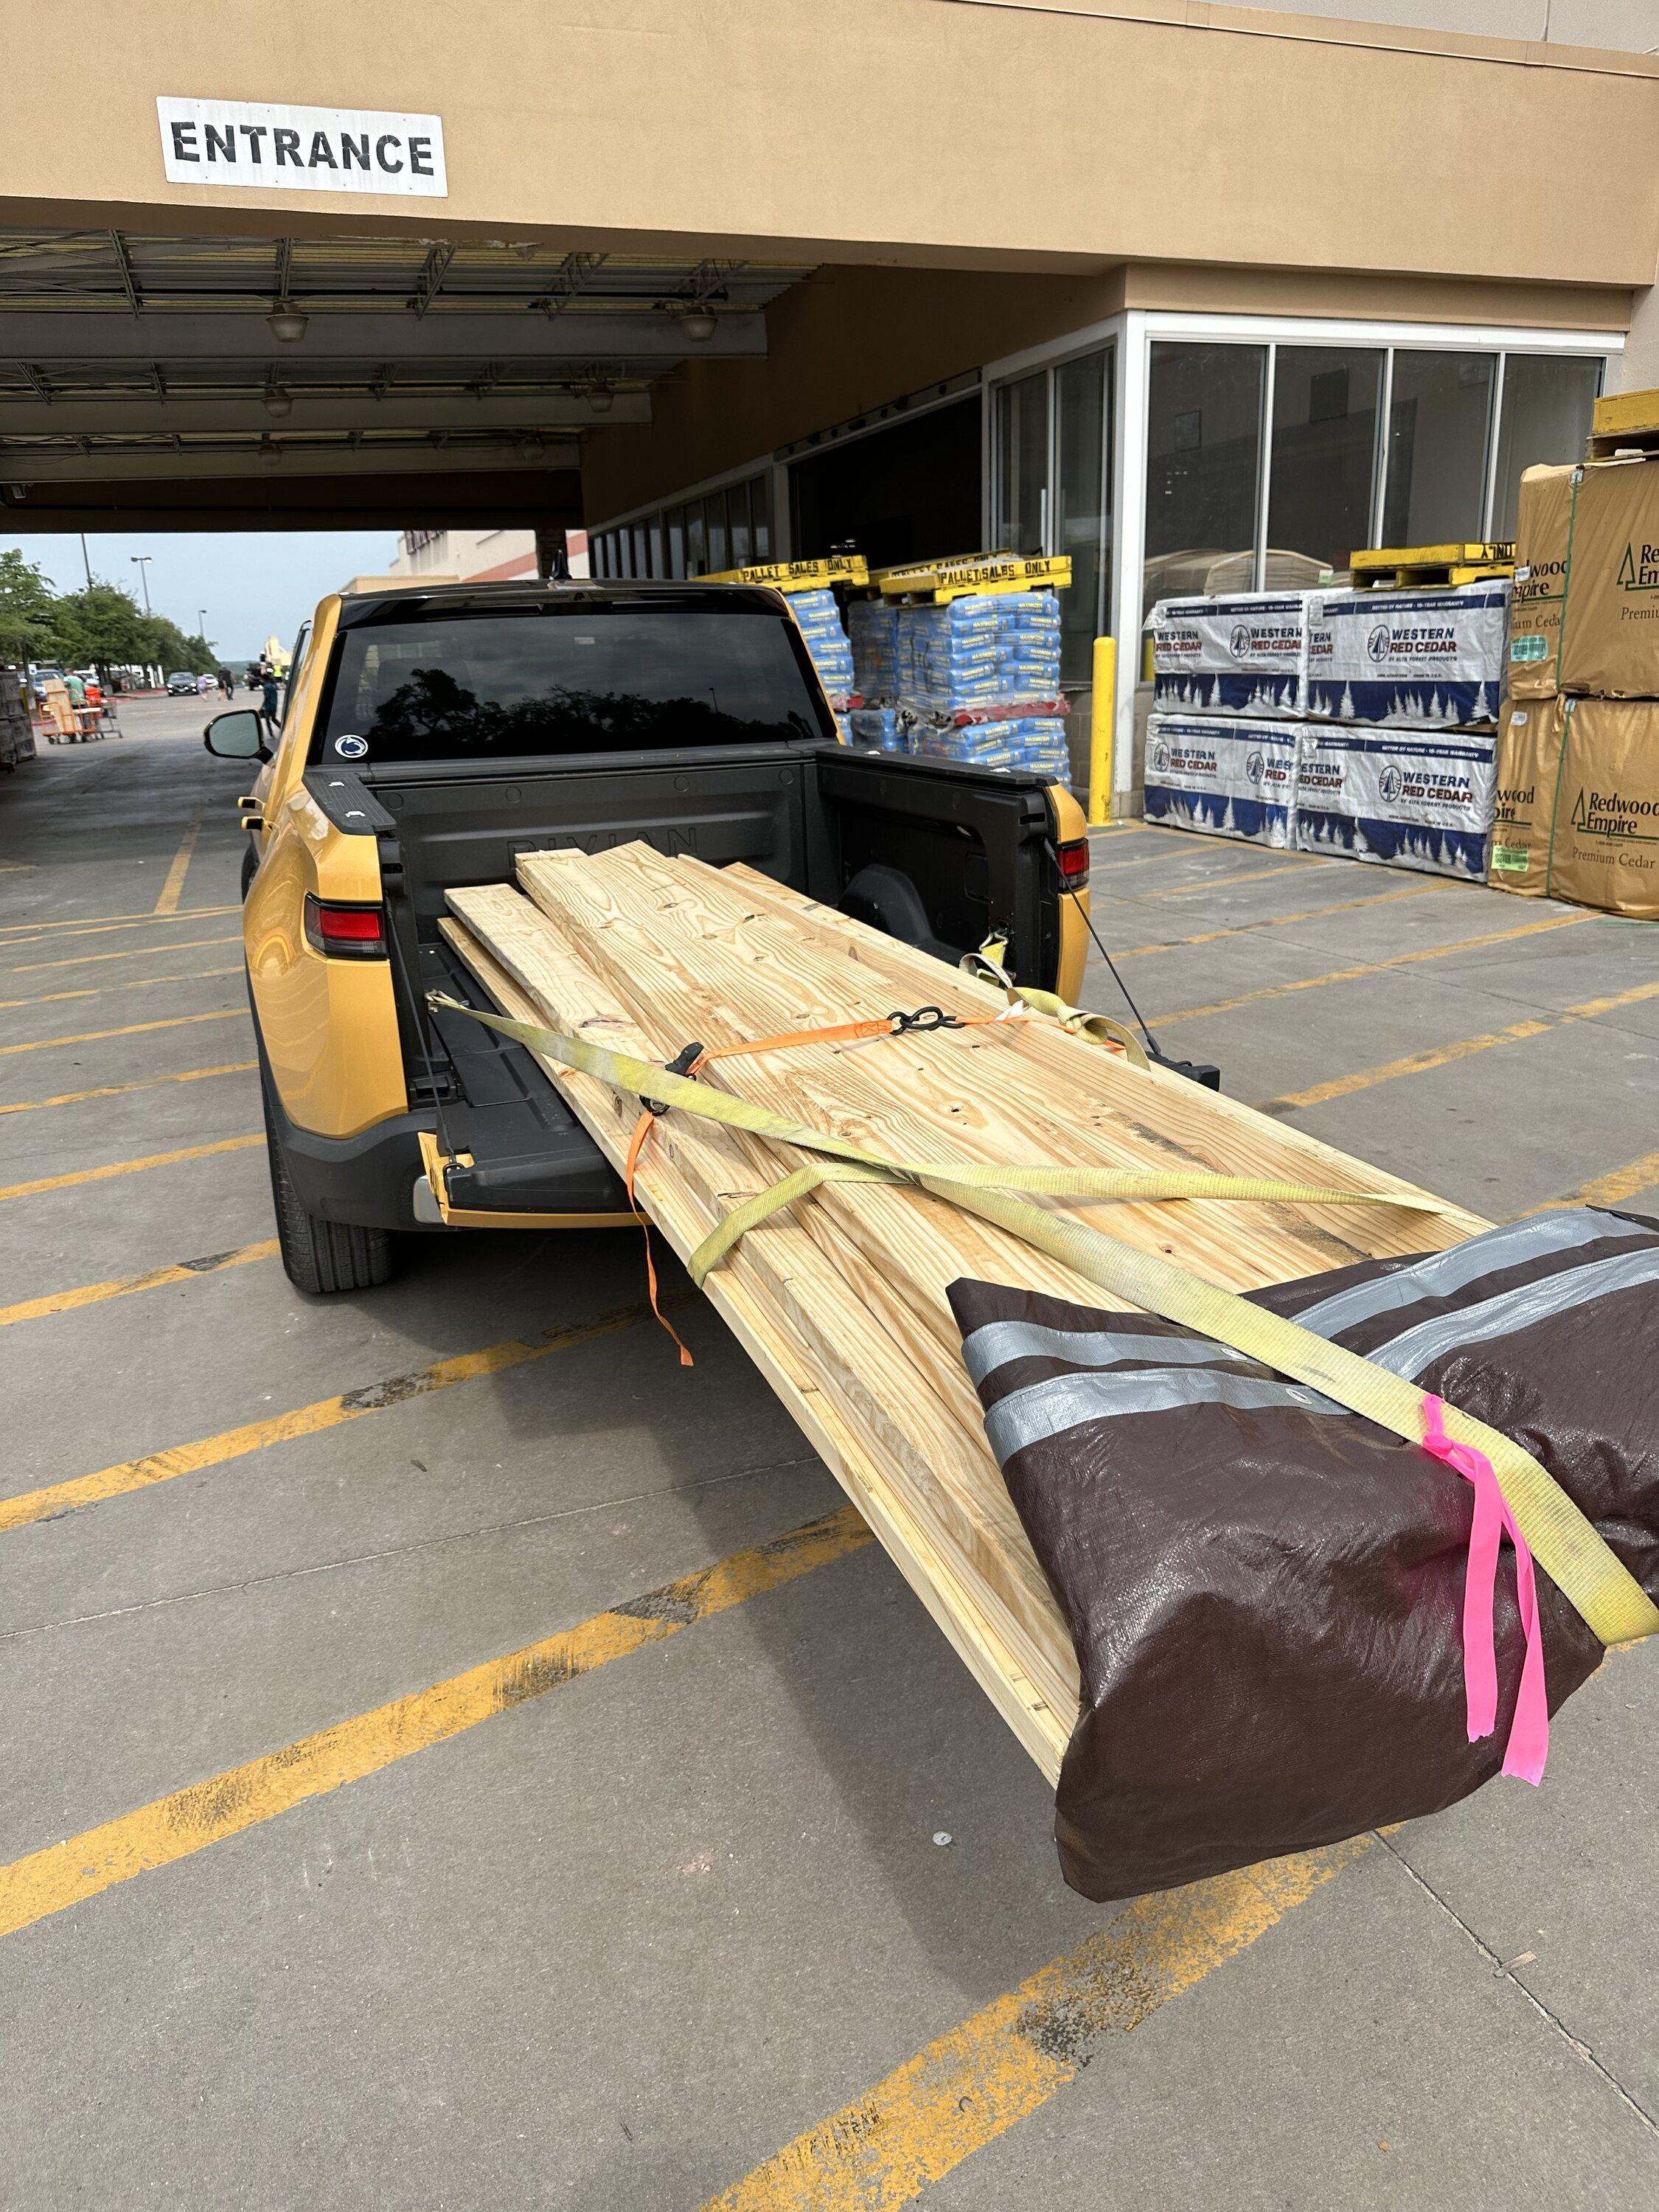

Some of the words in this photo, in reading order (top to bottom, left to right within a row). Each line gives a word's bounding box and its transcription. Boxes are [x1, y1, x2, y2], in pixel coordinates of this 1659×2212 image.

[170, 121, 434, 176] ENTRANCE
[742, 566, 779, 582] PALLET
[788, 561, 818, 575] SALES
[827, 557, 852, 571] ONLY
[939, 568, 981, 584] PALLET
[1025, 560, 1051, 574] ONLY
[1157, 630, 1198, 641] WESTERN
[1251, 627, 1302, 639] WESTERN
[1391, 627, 1455, 640] WESTERN
[1155, 642, 1172, 652] RED
[1173, 641, 1202, 652] CEDAR
[1251, 640, 1270, 650] RED
[1389, 641, 1413, 653] RED
[1415, 641, 1457, 653] CEDAR
[1171, 748, 1215, 760] WESTERN
[1170, 759, 1186, 769] RED
[1187, 759, 1217, 771] CEDAR
[1265, 769, 1287, 781] RED
[1402, 771, 1470, 789] WESTERN
[1312, 776, 1343, 788] CEDAR
[1402, 785, 1425, 798] RED
[1427, 786, 1473, 804] CEDAR
[1587, 811, 1638, 838] Empire
[1572, 847, 1615, 865] Premium
[1618, 852, 1655, 869] Cedar
